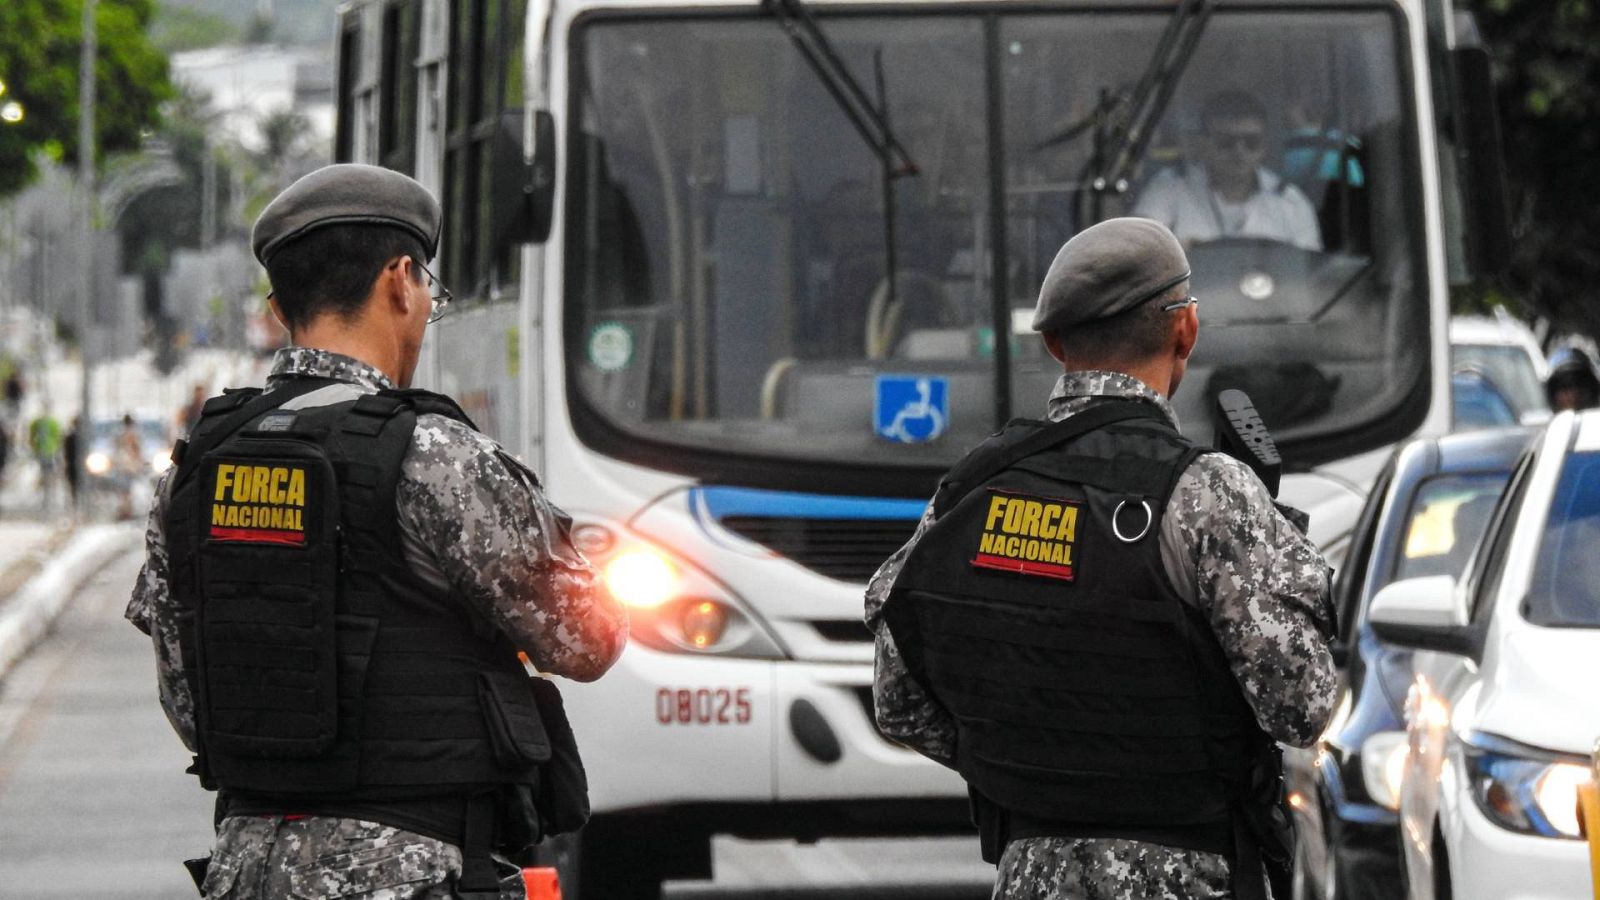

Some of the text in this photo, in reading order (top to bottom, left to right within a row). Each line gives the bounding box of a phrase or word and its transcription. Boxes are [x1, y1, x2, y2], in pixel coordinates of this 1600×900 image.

[212, 504, 304, 530] NACIONAL
[980, 533, 1072, 565] NACIONAL
[656, 688, 751, 723] 08025
